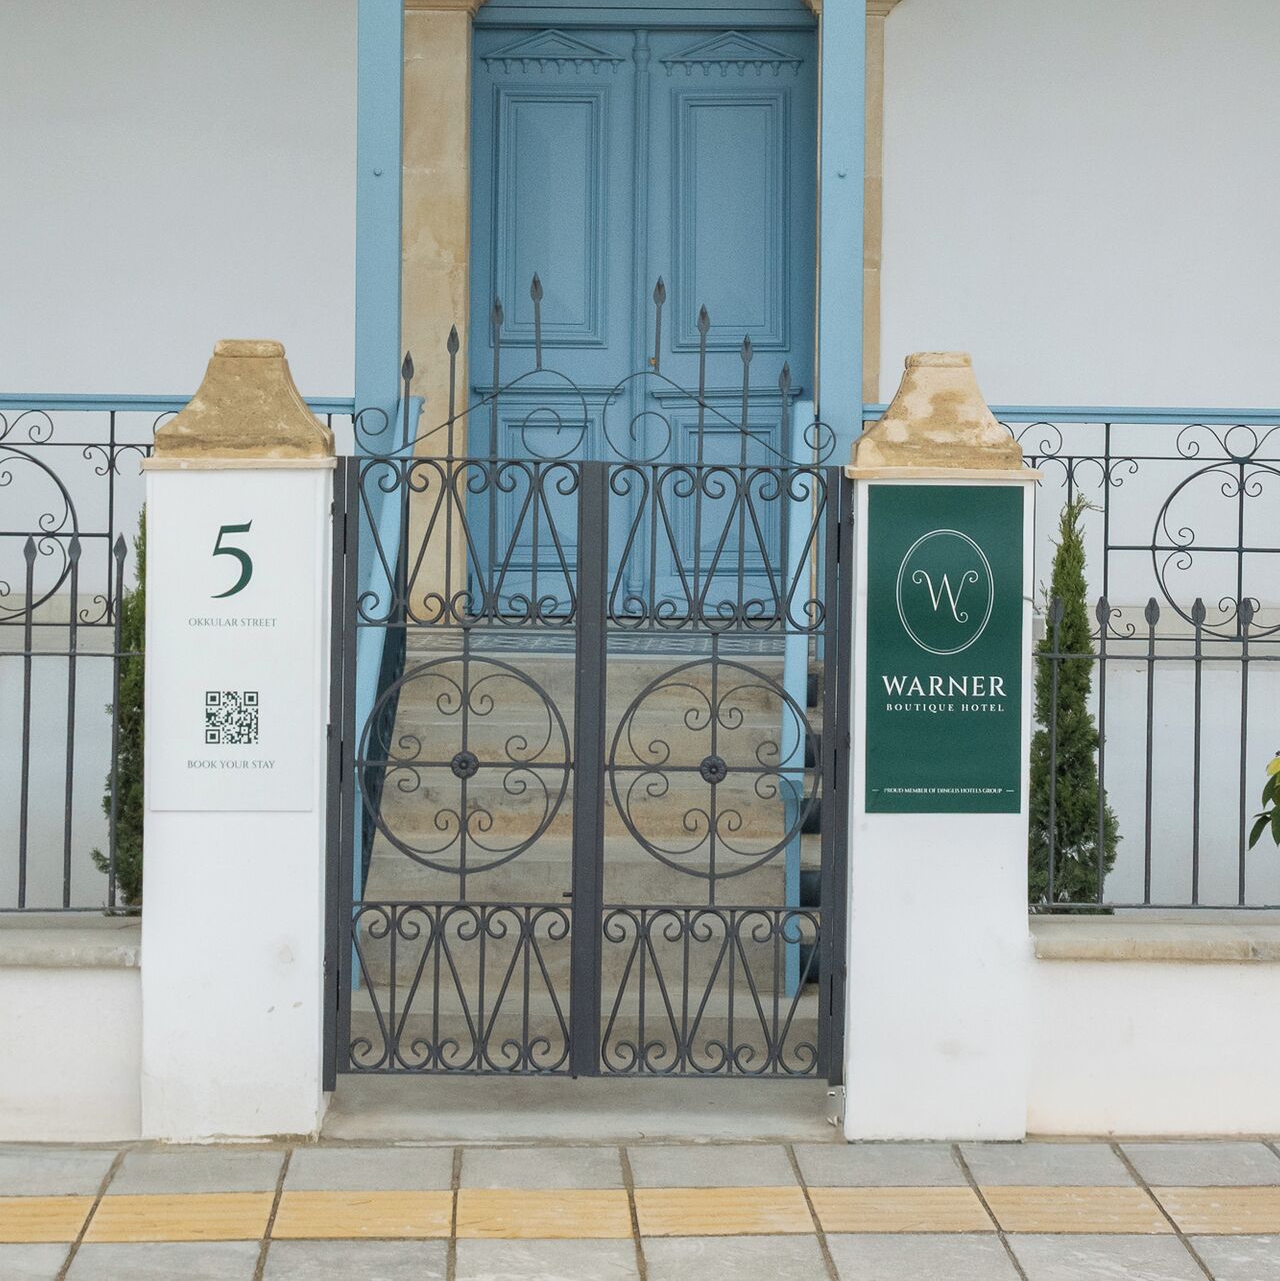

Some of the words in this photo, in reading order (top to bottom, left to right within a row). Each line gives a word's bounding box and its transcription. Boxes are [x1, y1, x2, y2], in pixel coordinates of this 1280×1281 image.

[210, 519, 253, 598] 5
[912, 570, 979, 623] W
[188, 617, 238, 627] OKKULAR
[239, 617, 277, 627] STREET
[881, 675, 1007, 697] WARNER
[886, 703, 955, 714] BOUTIQUE
[961, 703, 1005, 712] HOTEL
[187, 760, 217, 769] BOOK
[219, 760, 249, 769] YOUR
[250, 760, 276, 769] STAY
